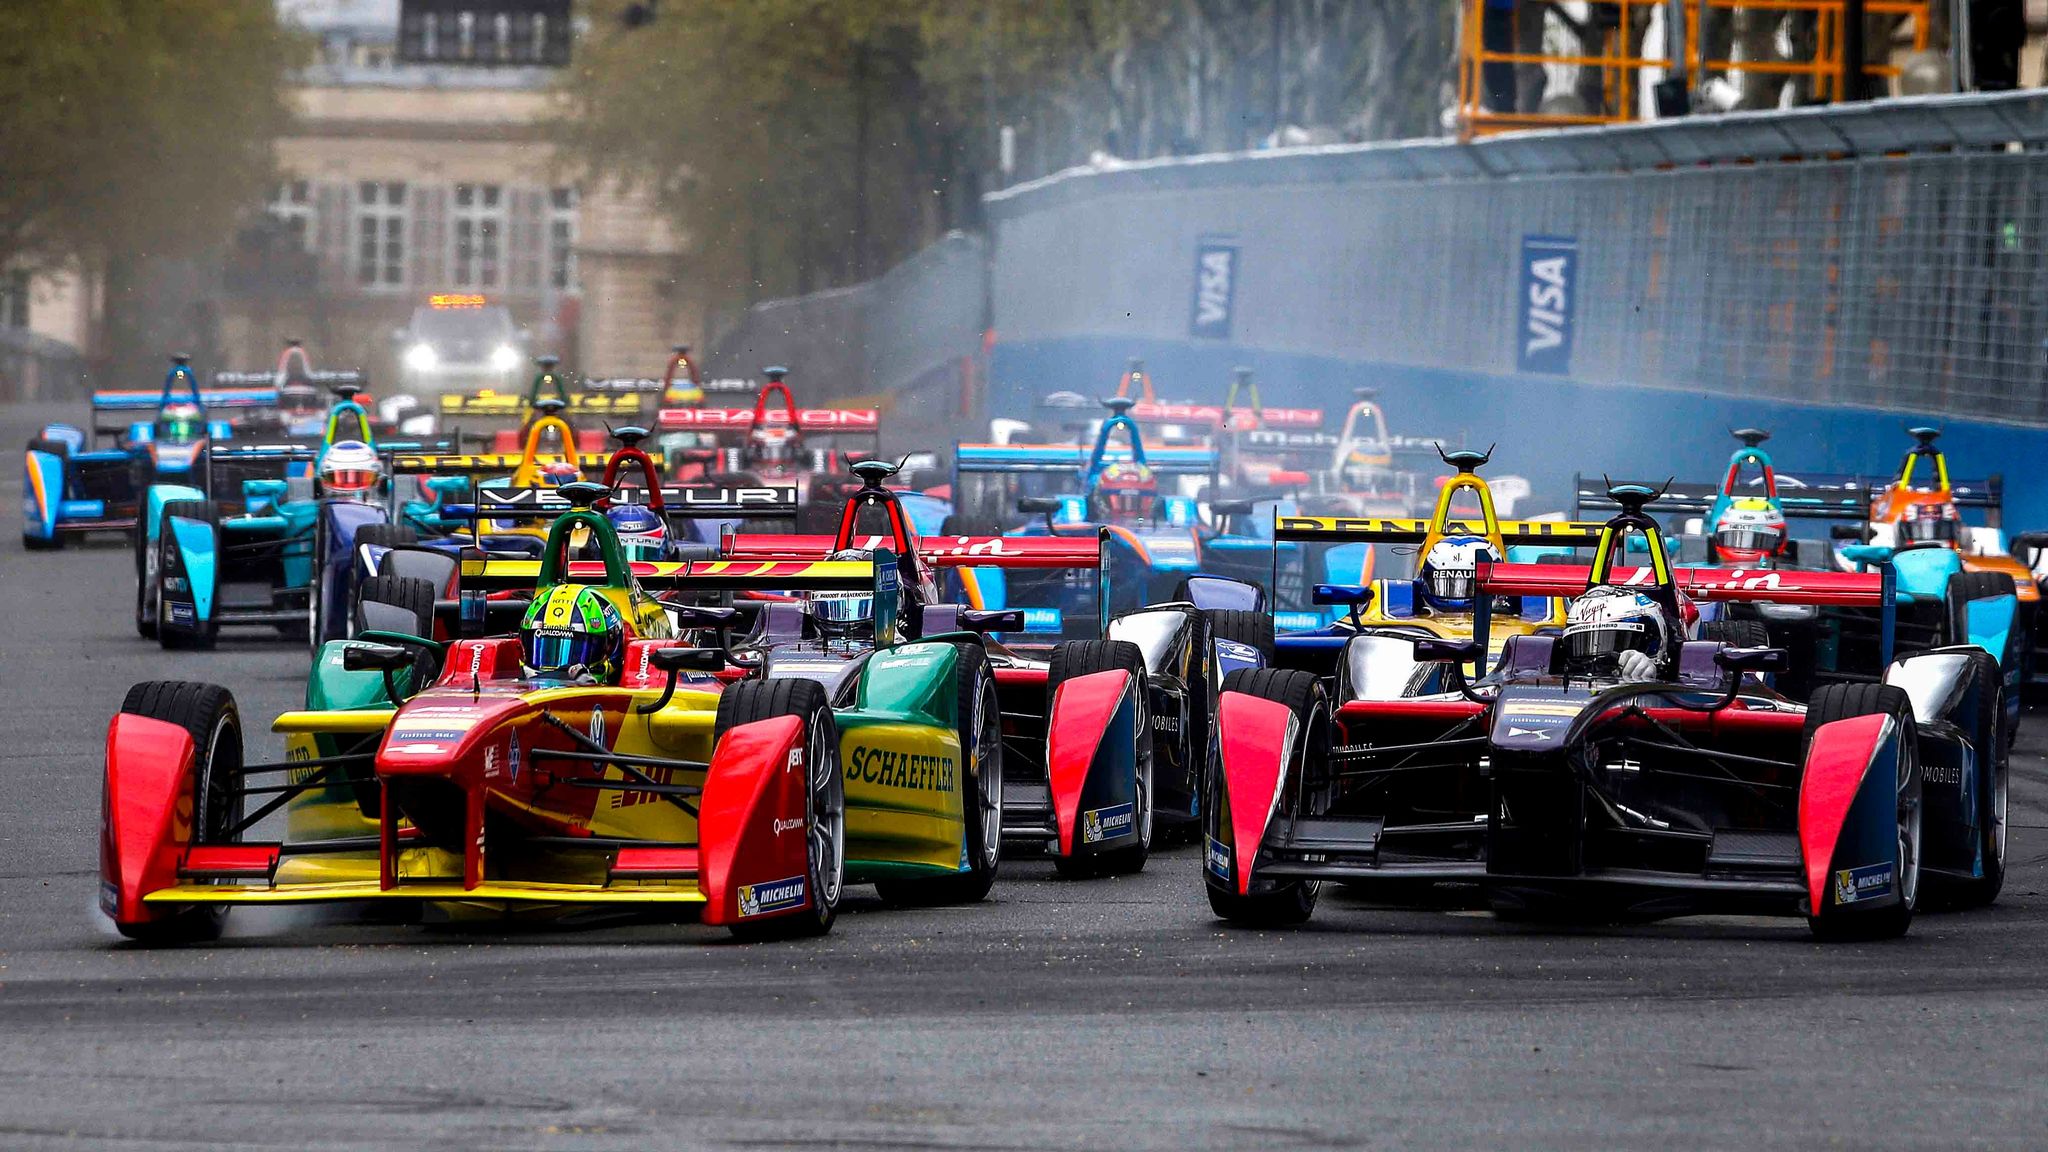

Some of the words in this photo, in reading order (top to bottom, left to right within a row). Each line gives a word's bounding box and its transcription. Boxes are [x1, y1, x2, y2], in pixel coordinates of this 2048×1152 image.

[1197, 251, 1230, 325] VISA
[1526, 257, 1567, 357] VISA
[658, 408, 876, 423] DRAGON
[1580, 599, 1606, 621] Virgin
[535, 629, 574, 638] QUALCOMM
[787, 748, 802, 773] ABT
[846, 745, 954, 792] SCHAEFFLER
[774, 818, 803, 837] QUALCOMM
[1102, 812, 1132, 829] MICHELIN
[760, 882, 804, 904] MICHELIN
